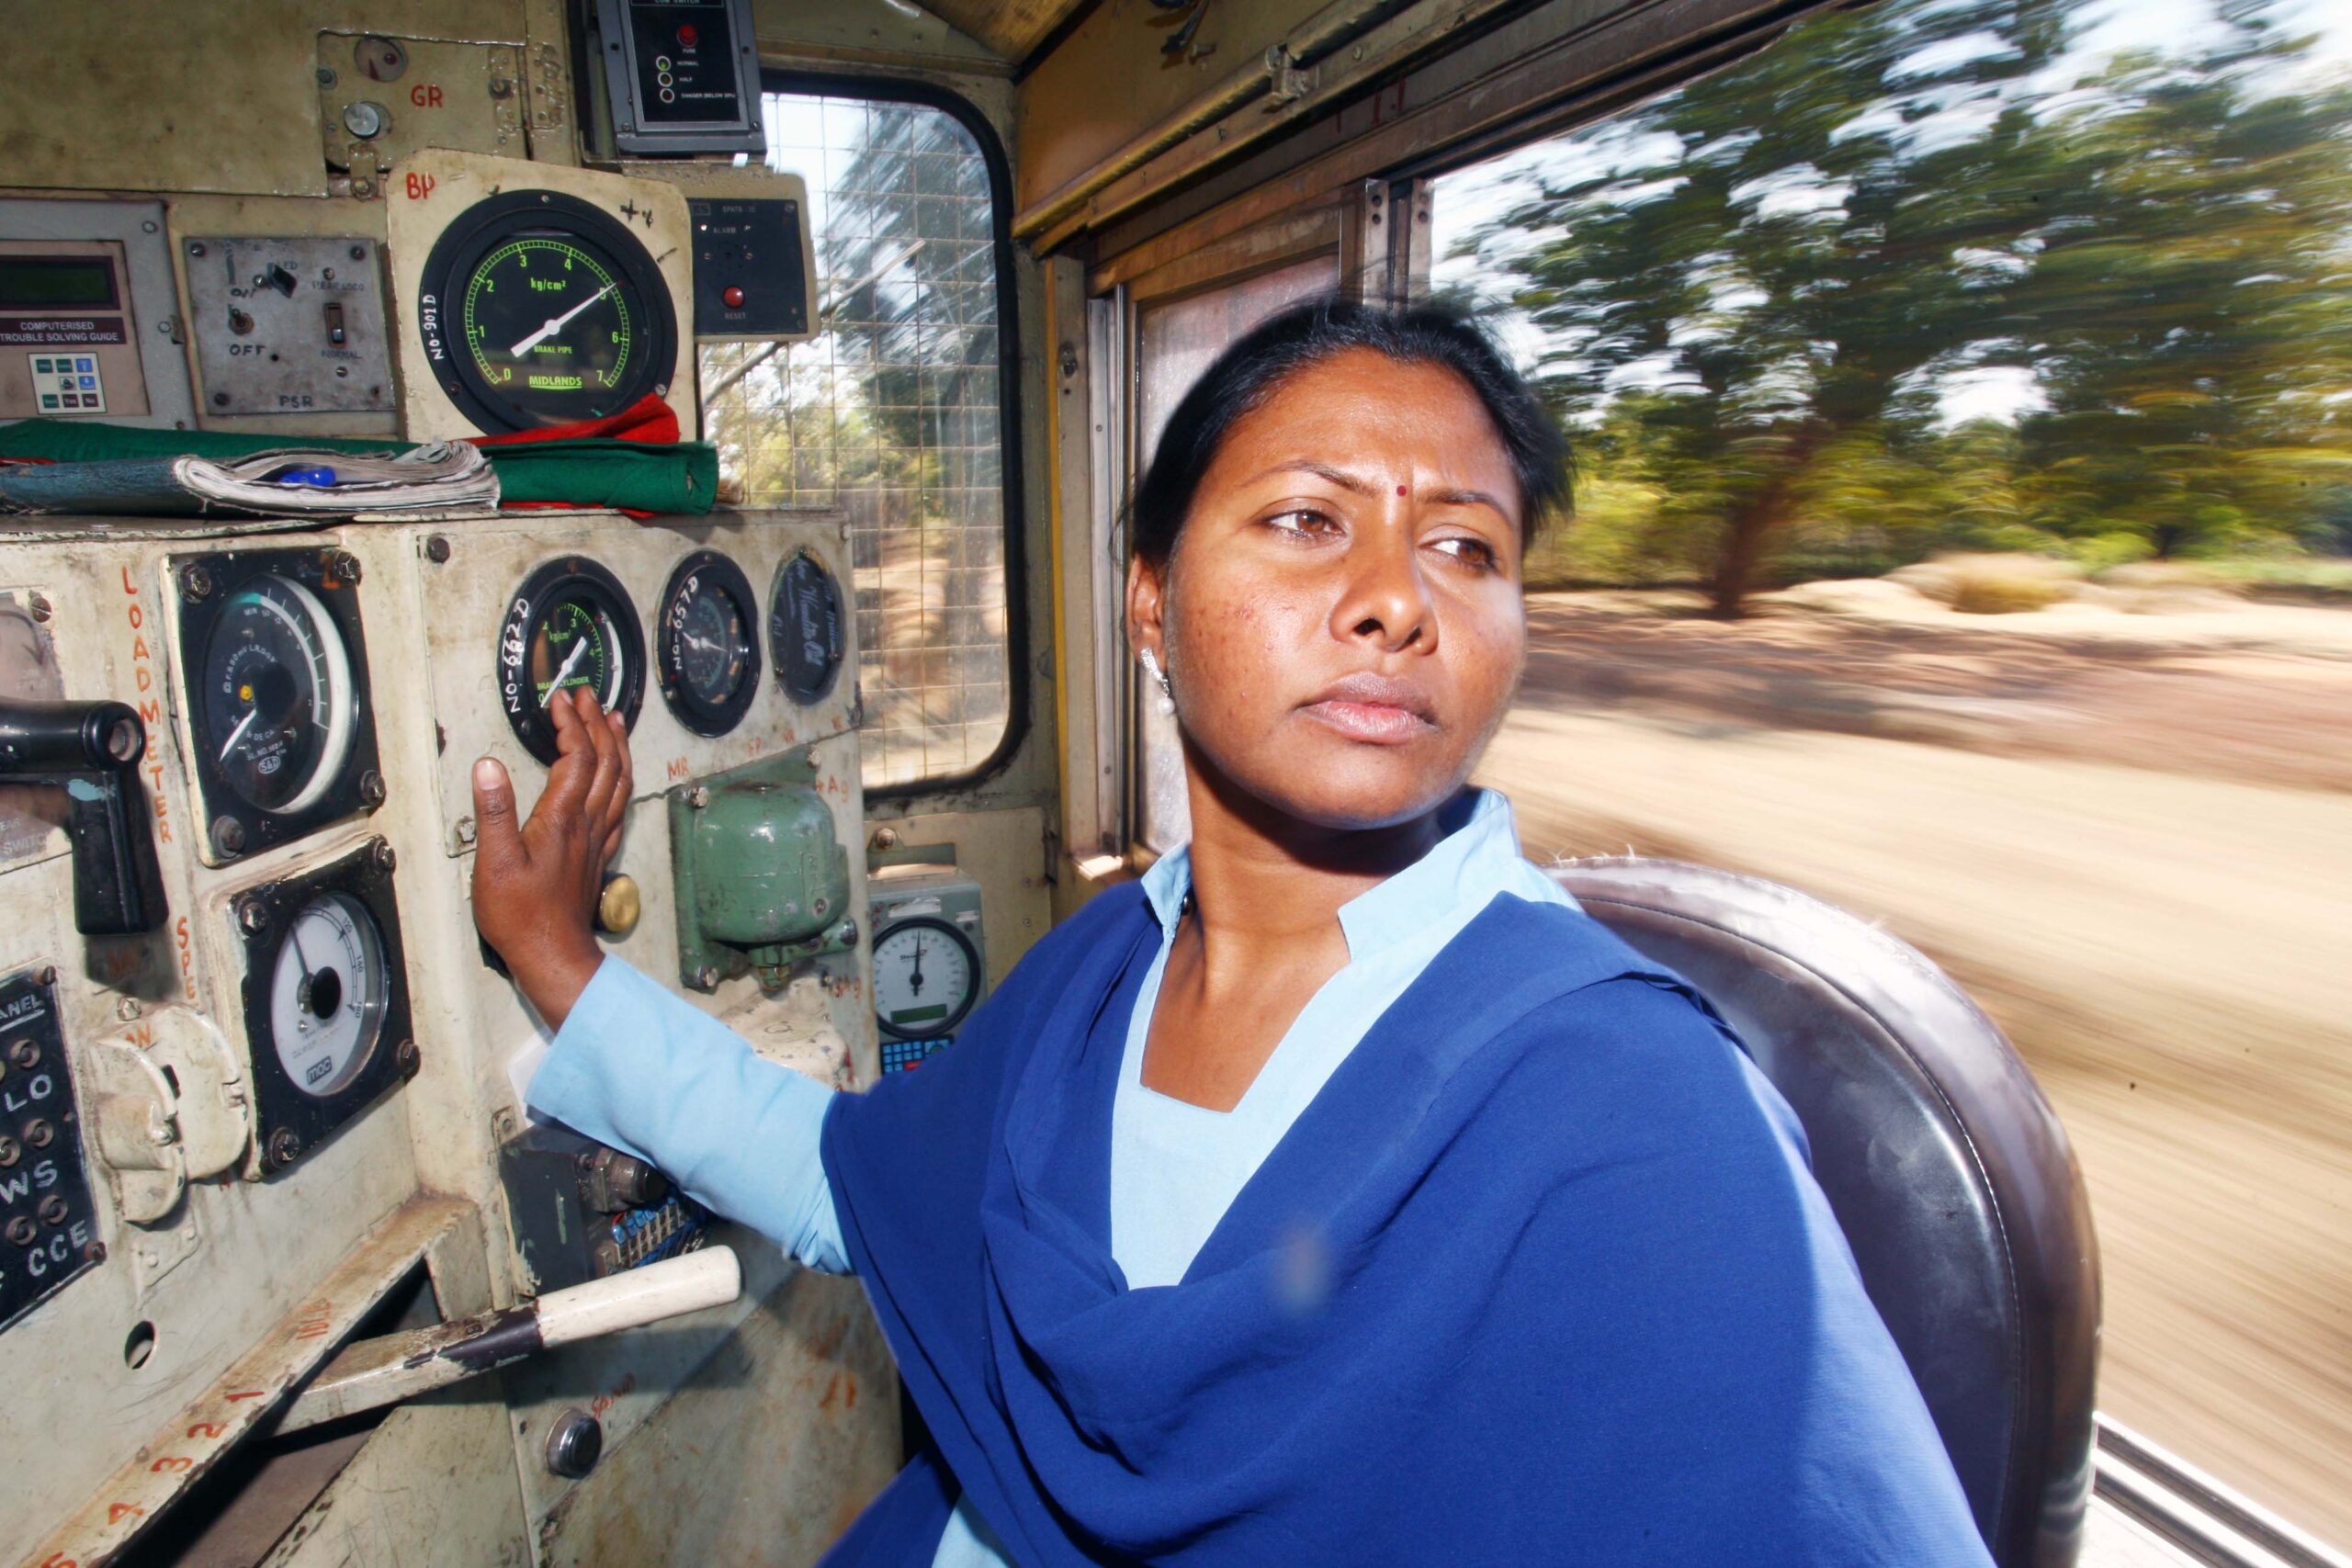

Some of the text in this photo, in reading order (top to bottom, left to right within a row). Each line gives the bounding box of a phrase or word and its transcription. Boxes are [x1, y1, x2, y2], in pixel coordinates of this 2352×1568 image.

[411, 85, 444, 108] GR
[406, 173, 435, 200] BP
[519, 255, 527, 267] 3
[564, 259, 571, 271] 4
[486, 279, 494, 292] 2
[20, 321, 95, 331] COMPUTERISED
[479, 325, 485, 337] 1
[0, 333, 119, 342] TROUBLE SOLVING GUIDE
[612, 332, 618, 344] 6
[230, 344, 266, 356] OFF
[503, 368, 511, 381] 0
[596, 369, 603, 382] 7
[529, 376, 582, 386] MIDLANDS
[279, 395, 313, 408] PSR
[571, 618, 577, 628] 3
[225, 1391, 265, 1402] 1
[187, 1422, 228, 1439] 2
[151, 1457, 193, 1473] 3
[108, 1502, 144, 1525] 4
